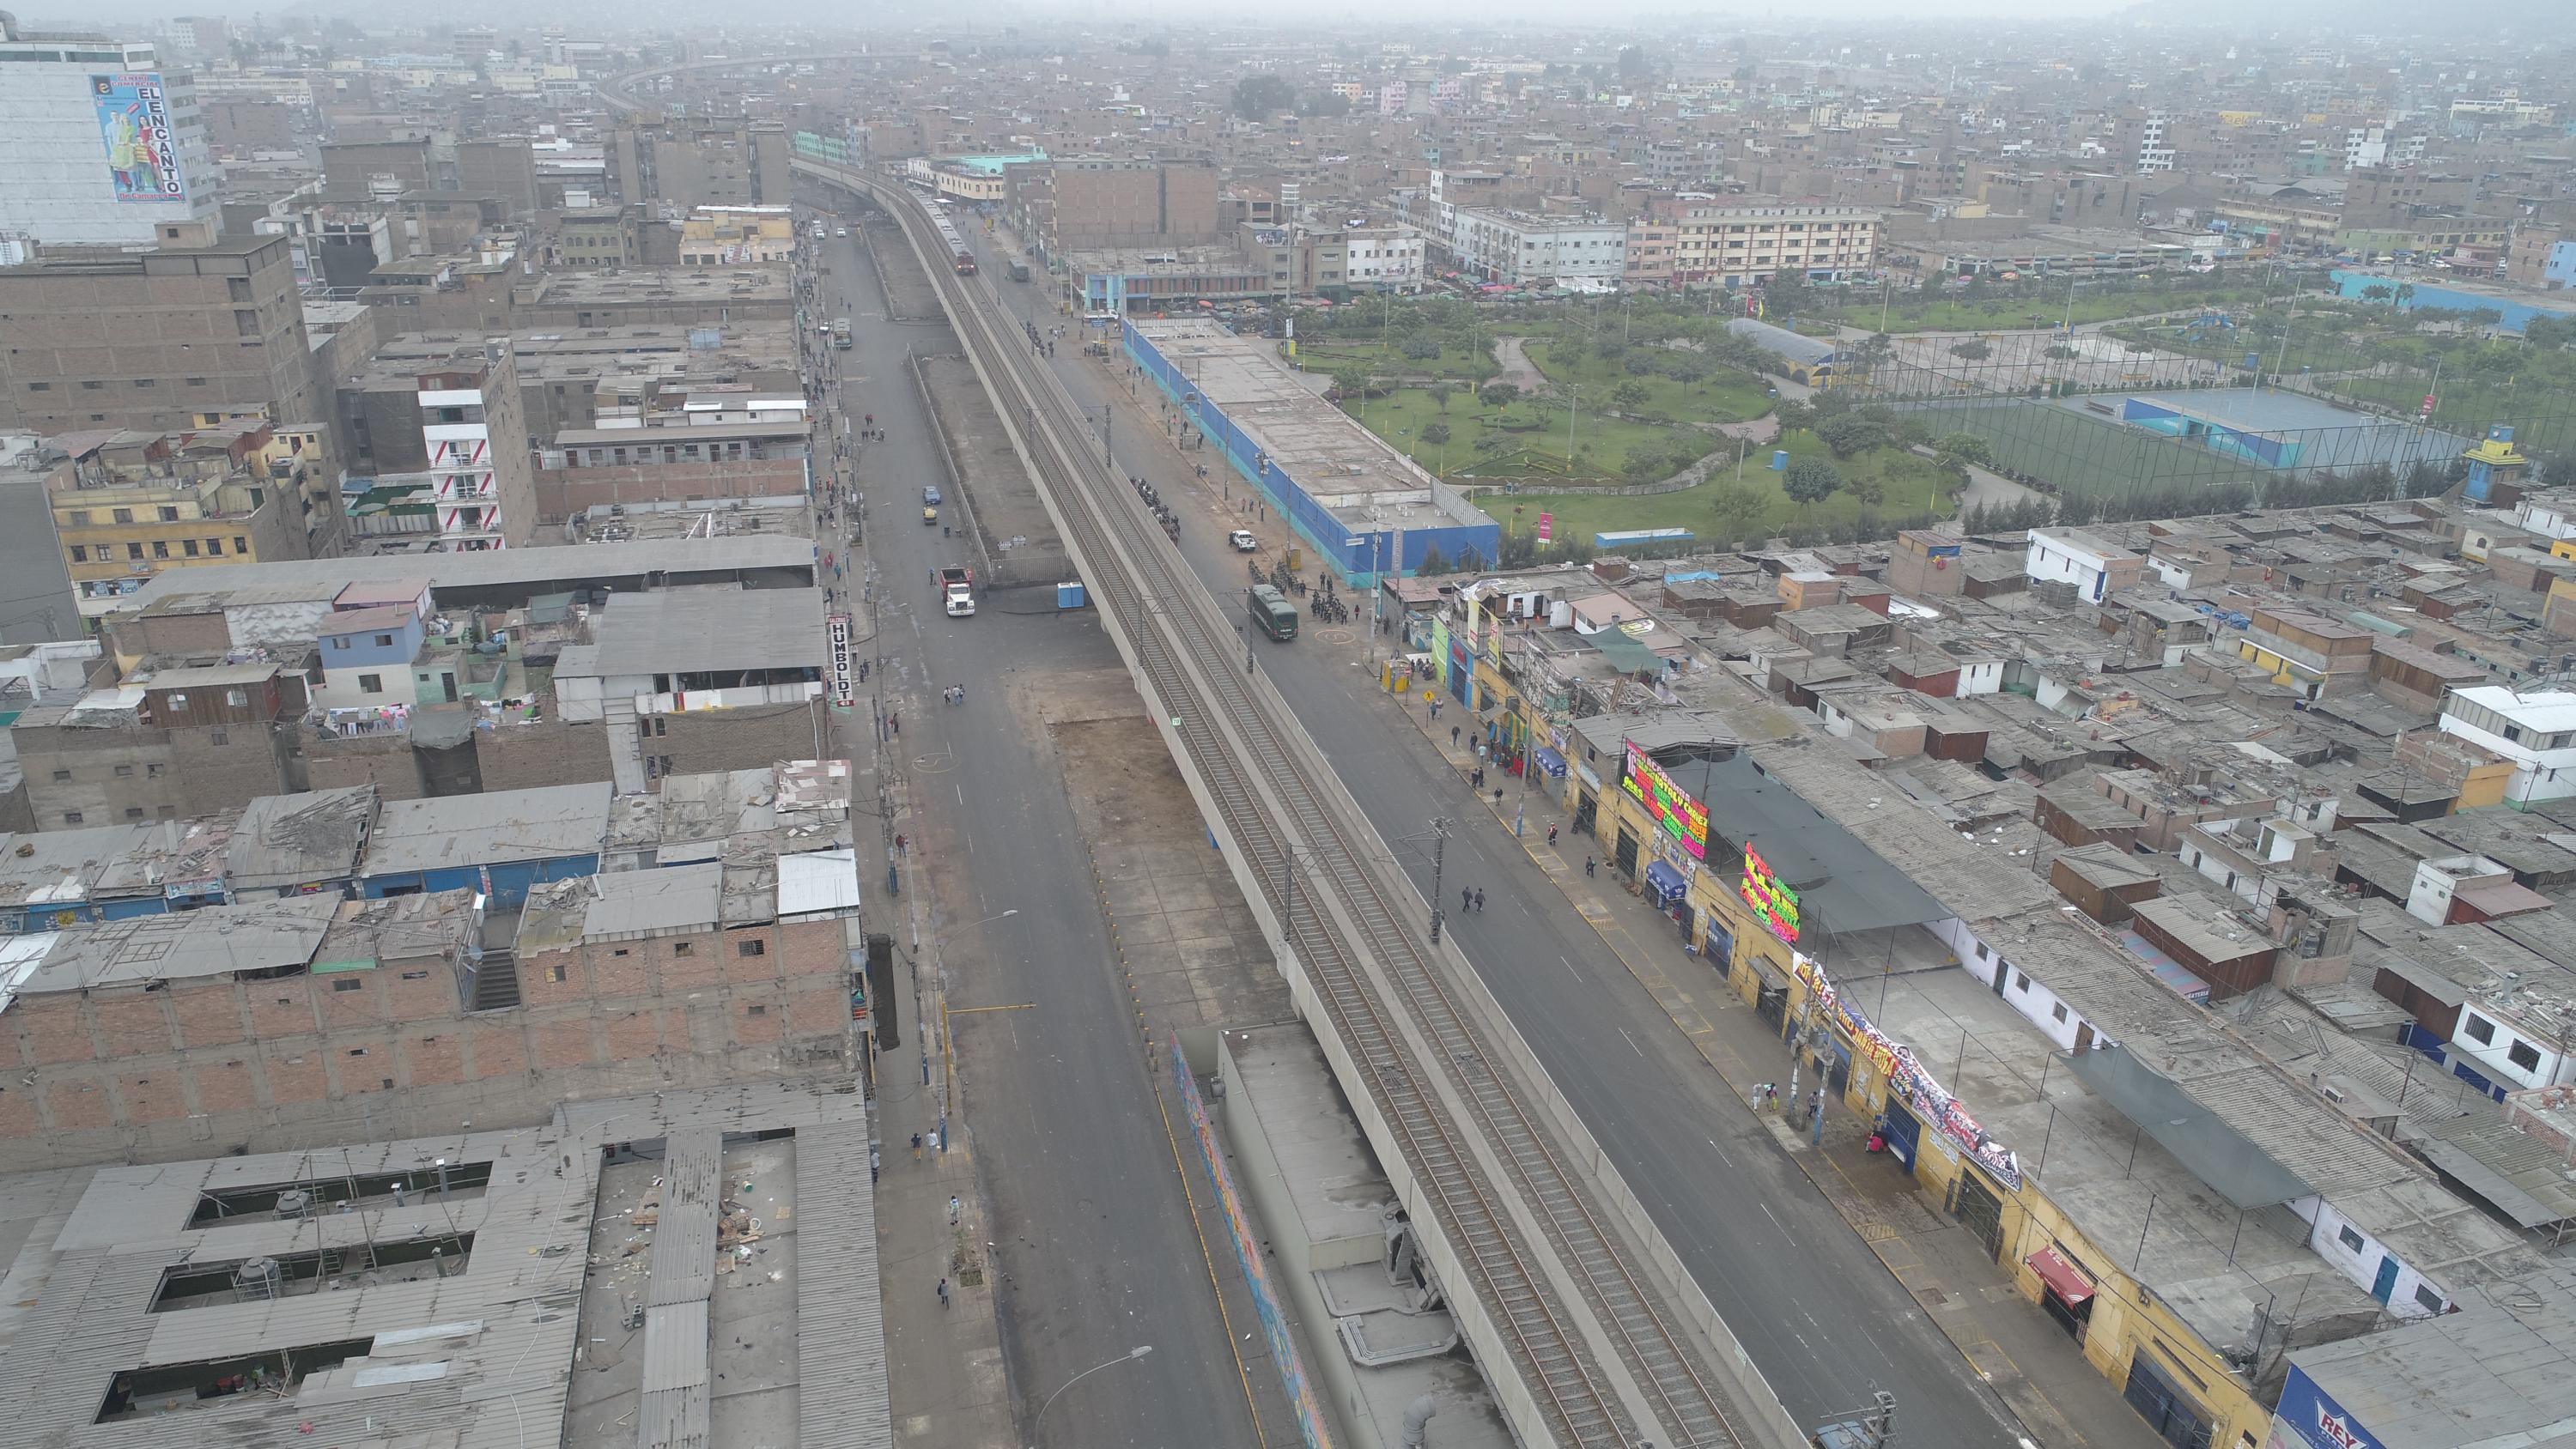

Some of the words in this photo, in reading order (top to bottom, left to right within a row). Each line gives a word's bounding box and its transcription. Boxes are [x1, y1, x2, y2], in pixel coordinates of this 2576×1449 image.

[138, 88, 160, 100] EL
[149, 101, 179, 192] ENCANTO
[832, 624, 850, 700] HUMBOLDT
[1626, 750, 1637, 778] 16
[1654, 775, 1683, 808] NATALY
[1684, 802, 1709, 827] CHAVEZ
[2321, 1413, 2358, 1449] REY
